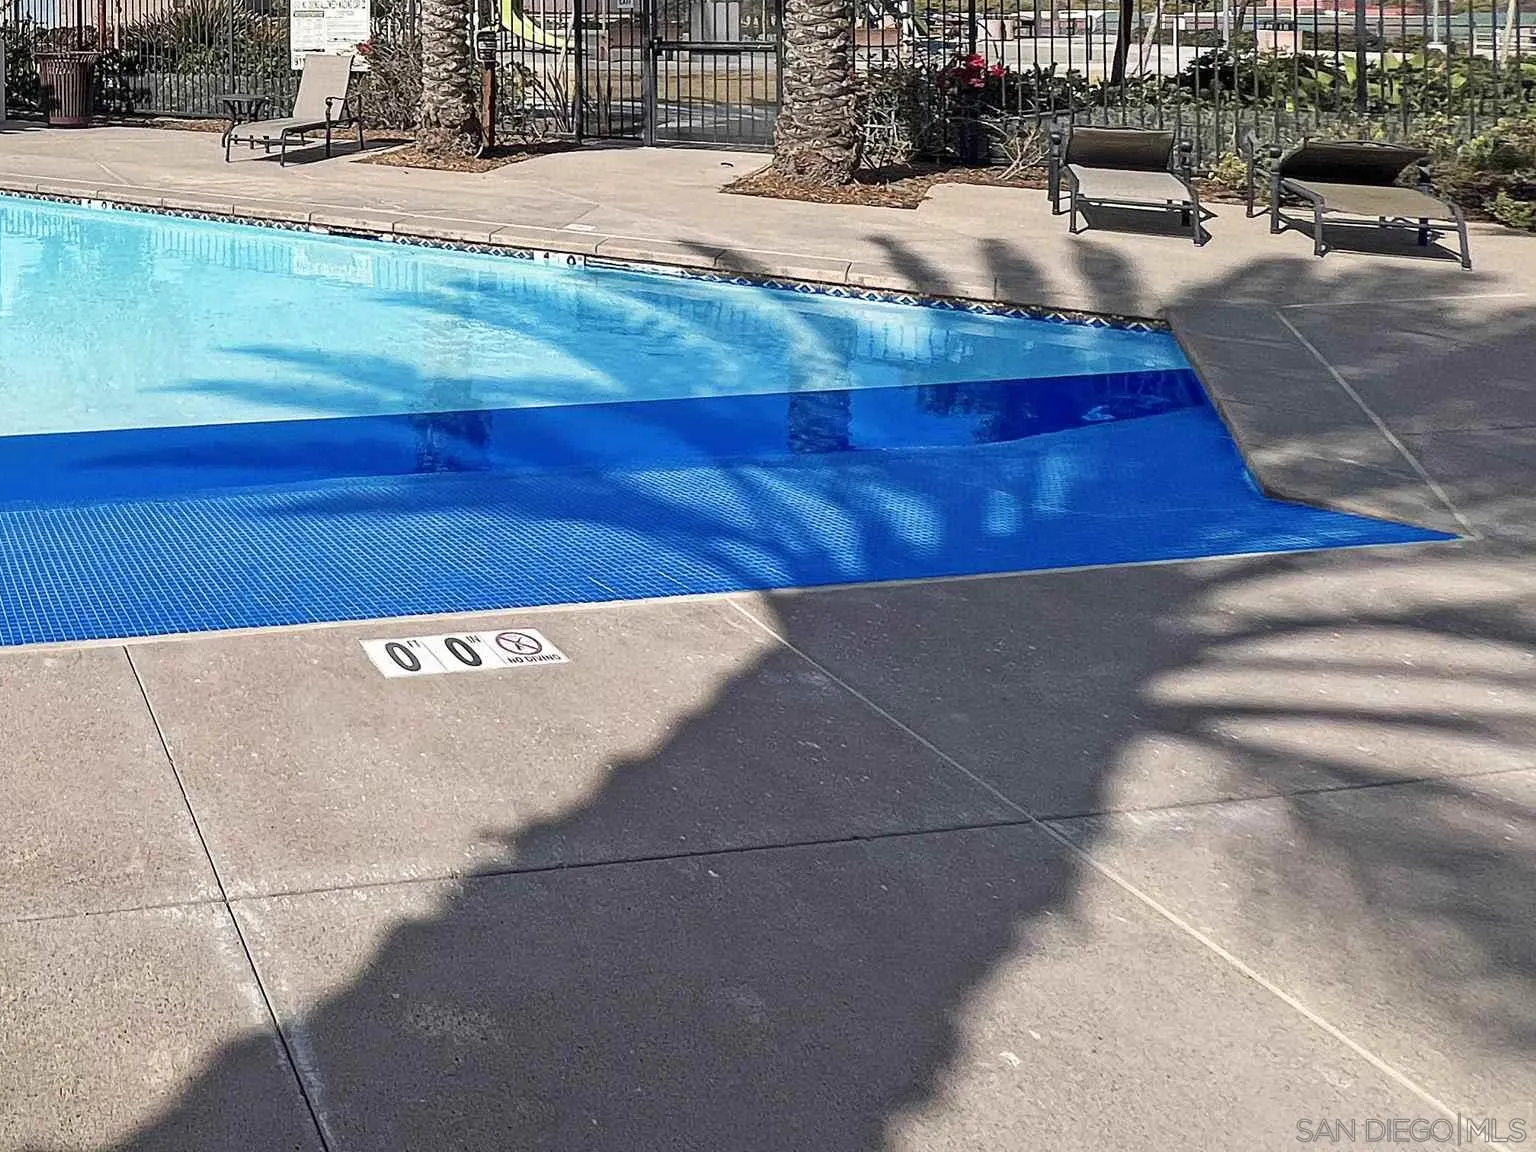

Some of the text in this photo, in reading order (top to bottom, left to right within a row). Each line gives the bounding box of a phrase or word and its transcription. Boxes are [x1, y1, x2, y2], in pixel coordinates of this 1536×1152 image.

[384, 642, 422, 672] 0
[444, 637, 483, 667] 0
[507, 654, 561, 664] NO DIVING
